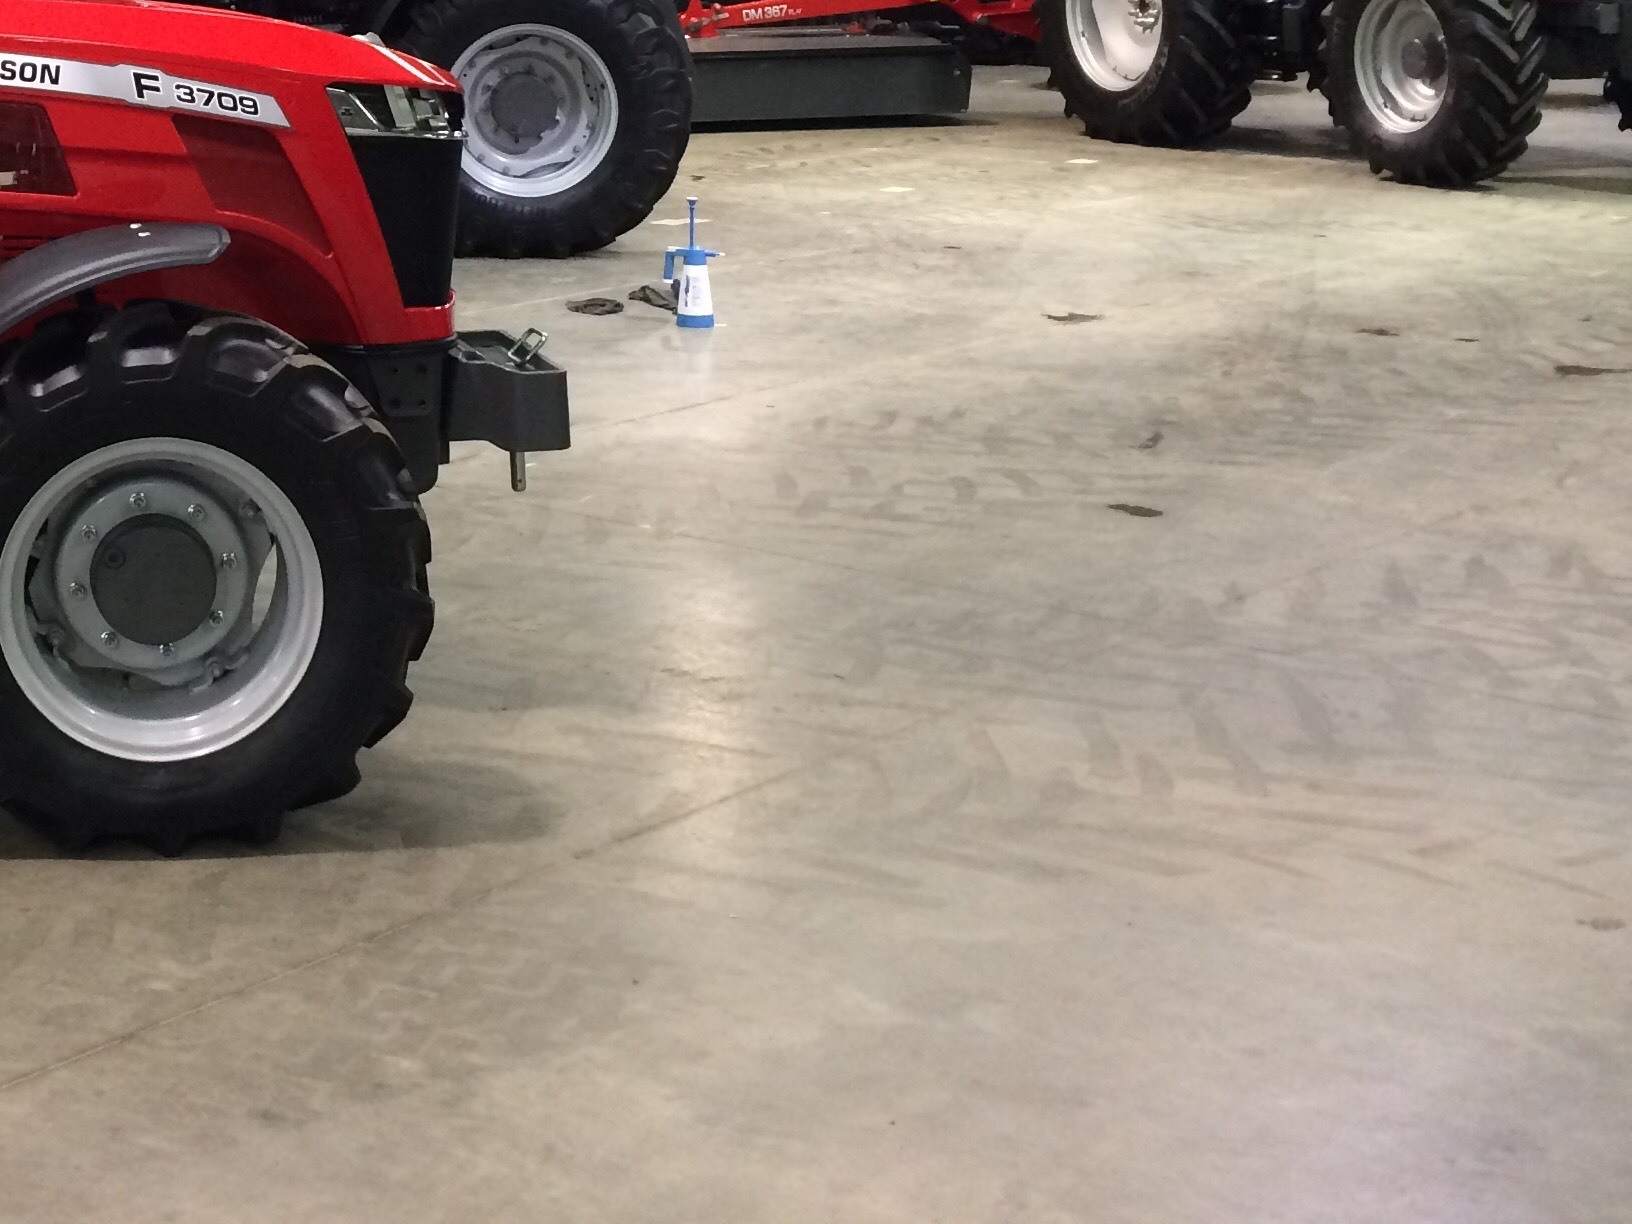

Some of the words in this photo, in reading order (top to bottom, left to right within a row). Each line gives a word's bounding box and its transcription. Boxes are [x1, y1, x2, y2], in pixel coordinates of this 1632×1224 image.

[742, 7, 763, 22] DM
[764, 4, 788, 19] 367
[132, 71, 161, 99] F
[174, 83, 259, 116] 3709
